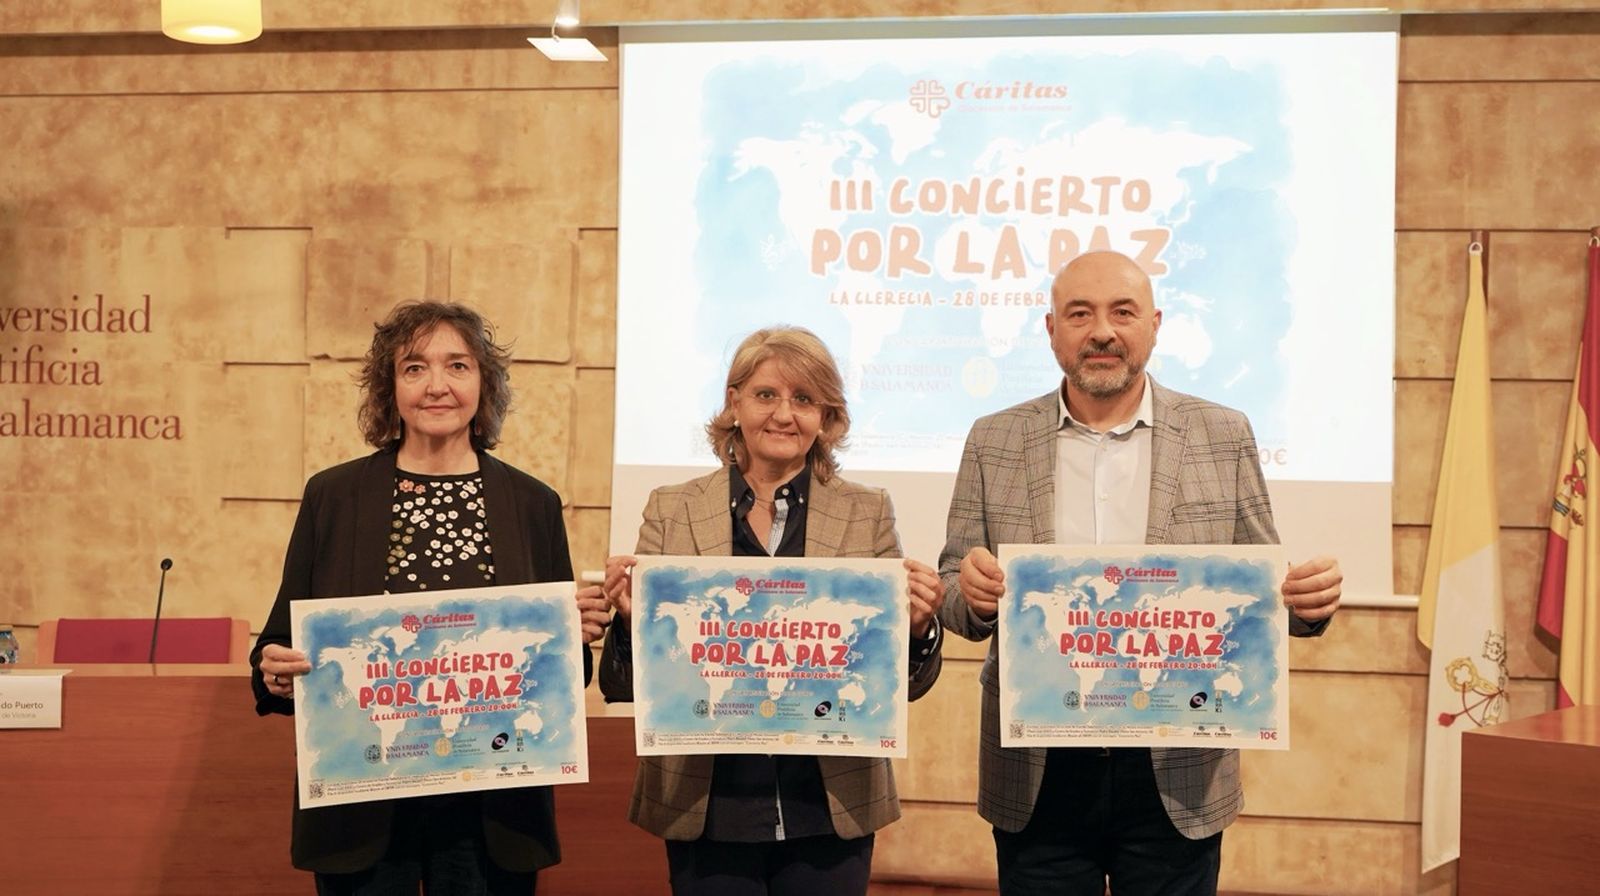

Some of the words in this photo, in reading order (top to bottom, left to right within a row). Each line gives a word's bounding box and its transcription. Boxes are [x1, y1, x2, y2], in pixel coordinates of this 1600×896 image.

[955, 80, 1068, 99] Cáritas
[830, 180, 873, 211] III
[811, 226, 931, 278] POR
[952, 226, 1027, 279] LA
[830, 292, 849, 305] LA
[953, 292, 974, 306] 28
[980, 292, 998, 306] DE
[0, 399, 183, 440] alamanca
[1125, 567, 1177, 577] Cáritas
[755, 579, 806, 589] Cáritas
[423, 613, 475, 624] Cáritas
[1068, 611, 1089, 626] III
[699, 621, 720, 636] III
[1060, 632, 1117, 656] POR
[1125, 632, 1160, 657] LA
[1169, 632, 1224, 657] PAZ
[691, 642, 746, 666] POR
[754, 643, 788, 667] LA
[796, 643, 849, 667] PAZ
[367, 662, 389, 679] III
[755, 671, 766, 679] 28
[359, 682, 417, 709] POR
[426, 678, 461, 704] LA
[469, 674, 522, 700] PAZ
[15, 701, 44, 709] Puerto
[370, 714, 380, 722] LA
[427, 709, 439, 717] 28
[439, 708, 449, 716] DE
[450, 705, 486, 714] FEBRERO
[1260, 731, 1278, 740] 10€
[880, 740, 897, 748] 10€
[561, 765, 578, 774] 10€
